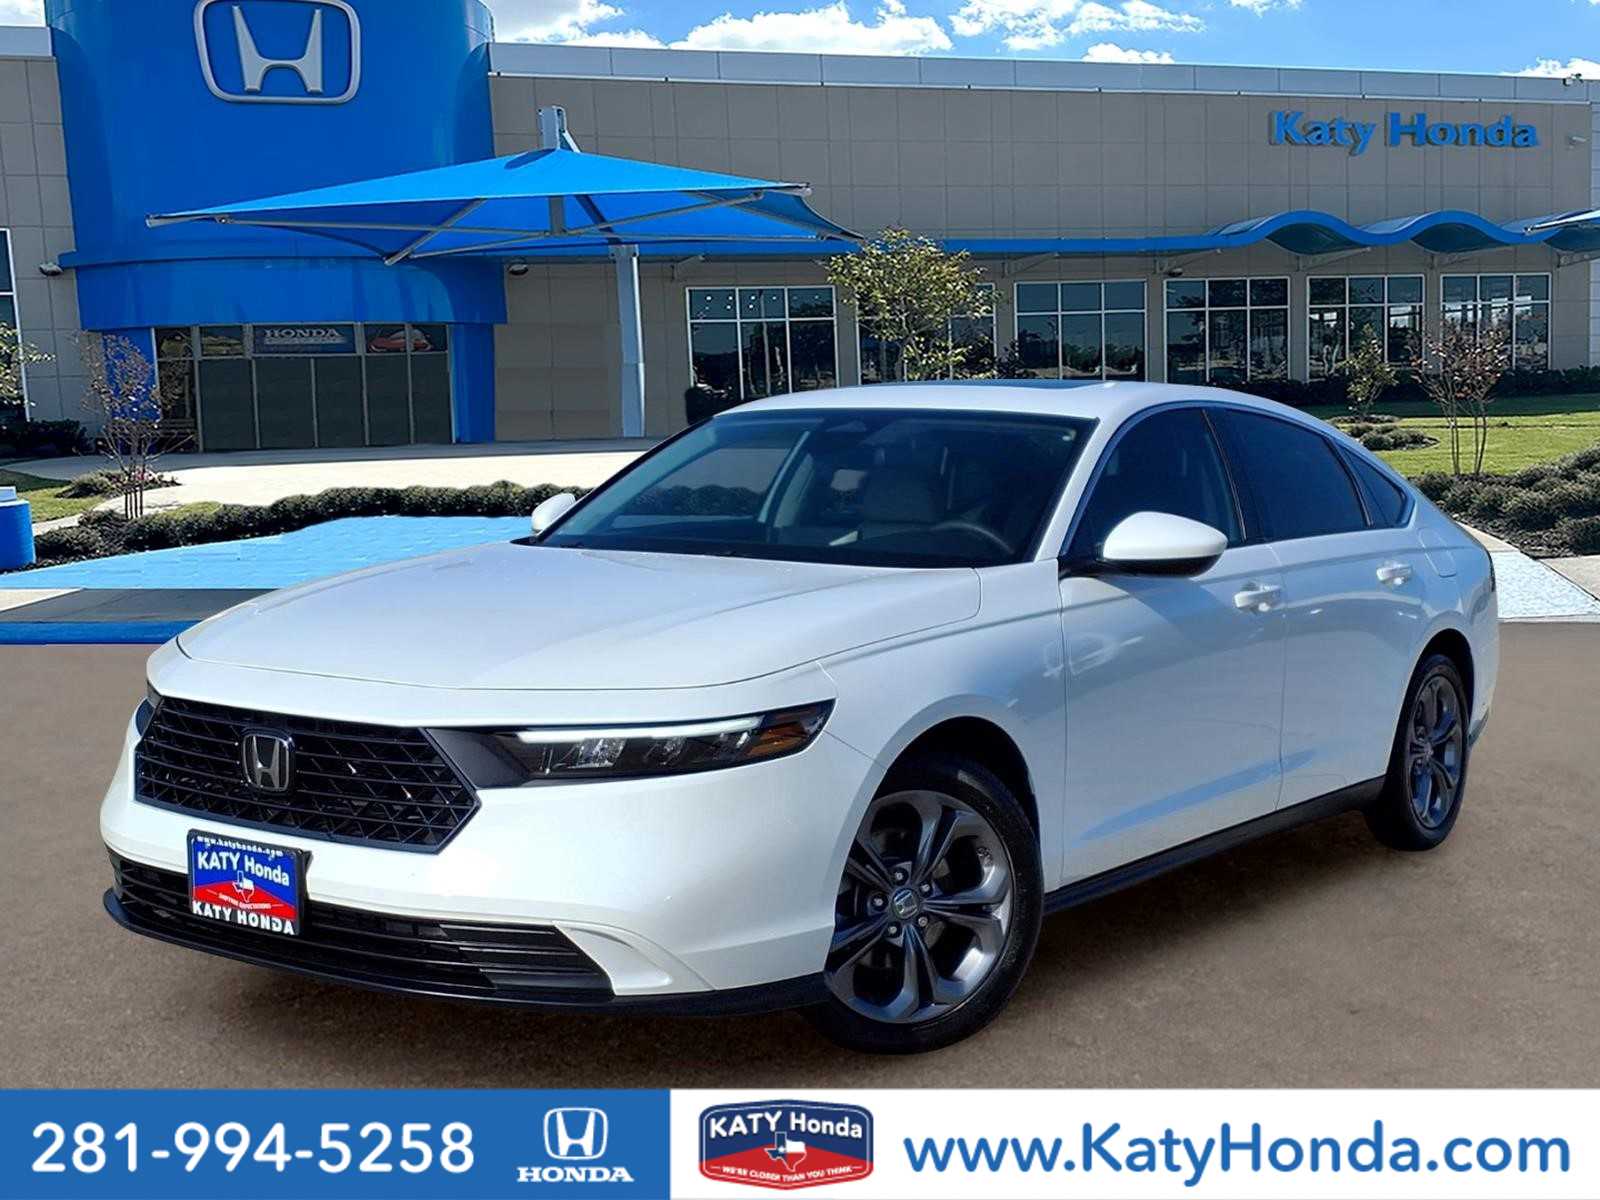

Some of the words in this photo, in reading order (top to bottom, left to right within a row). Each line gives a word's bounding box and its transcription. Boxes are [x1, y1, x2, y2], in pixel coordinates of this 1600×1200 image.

[1269, 110, 1376, 156] Katy
[1385, 111, 1540, 147] Honda
[264, 328, 342, 338] HONDA
[197, 851, 240, 870] KATY
[244, 854, 290, 887] Honda
[192, 900, 232, 922] KATY
[237, 909, 295, 936] HONDA
